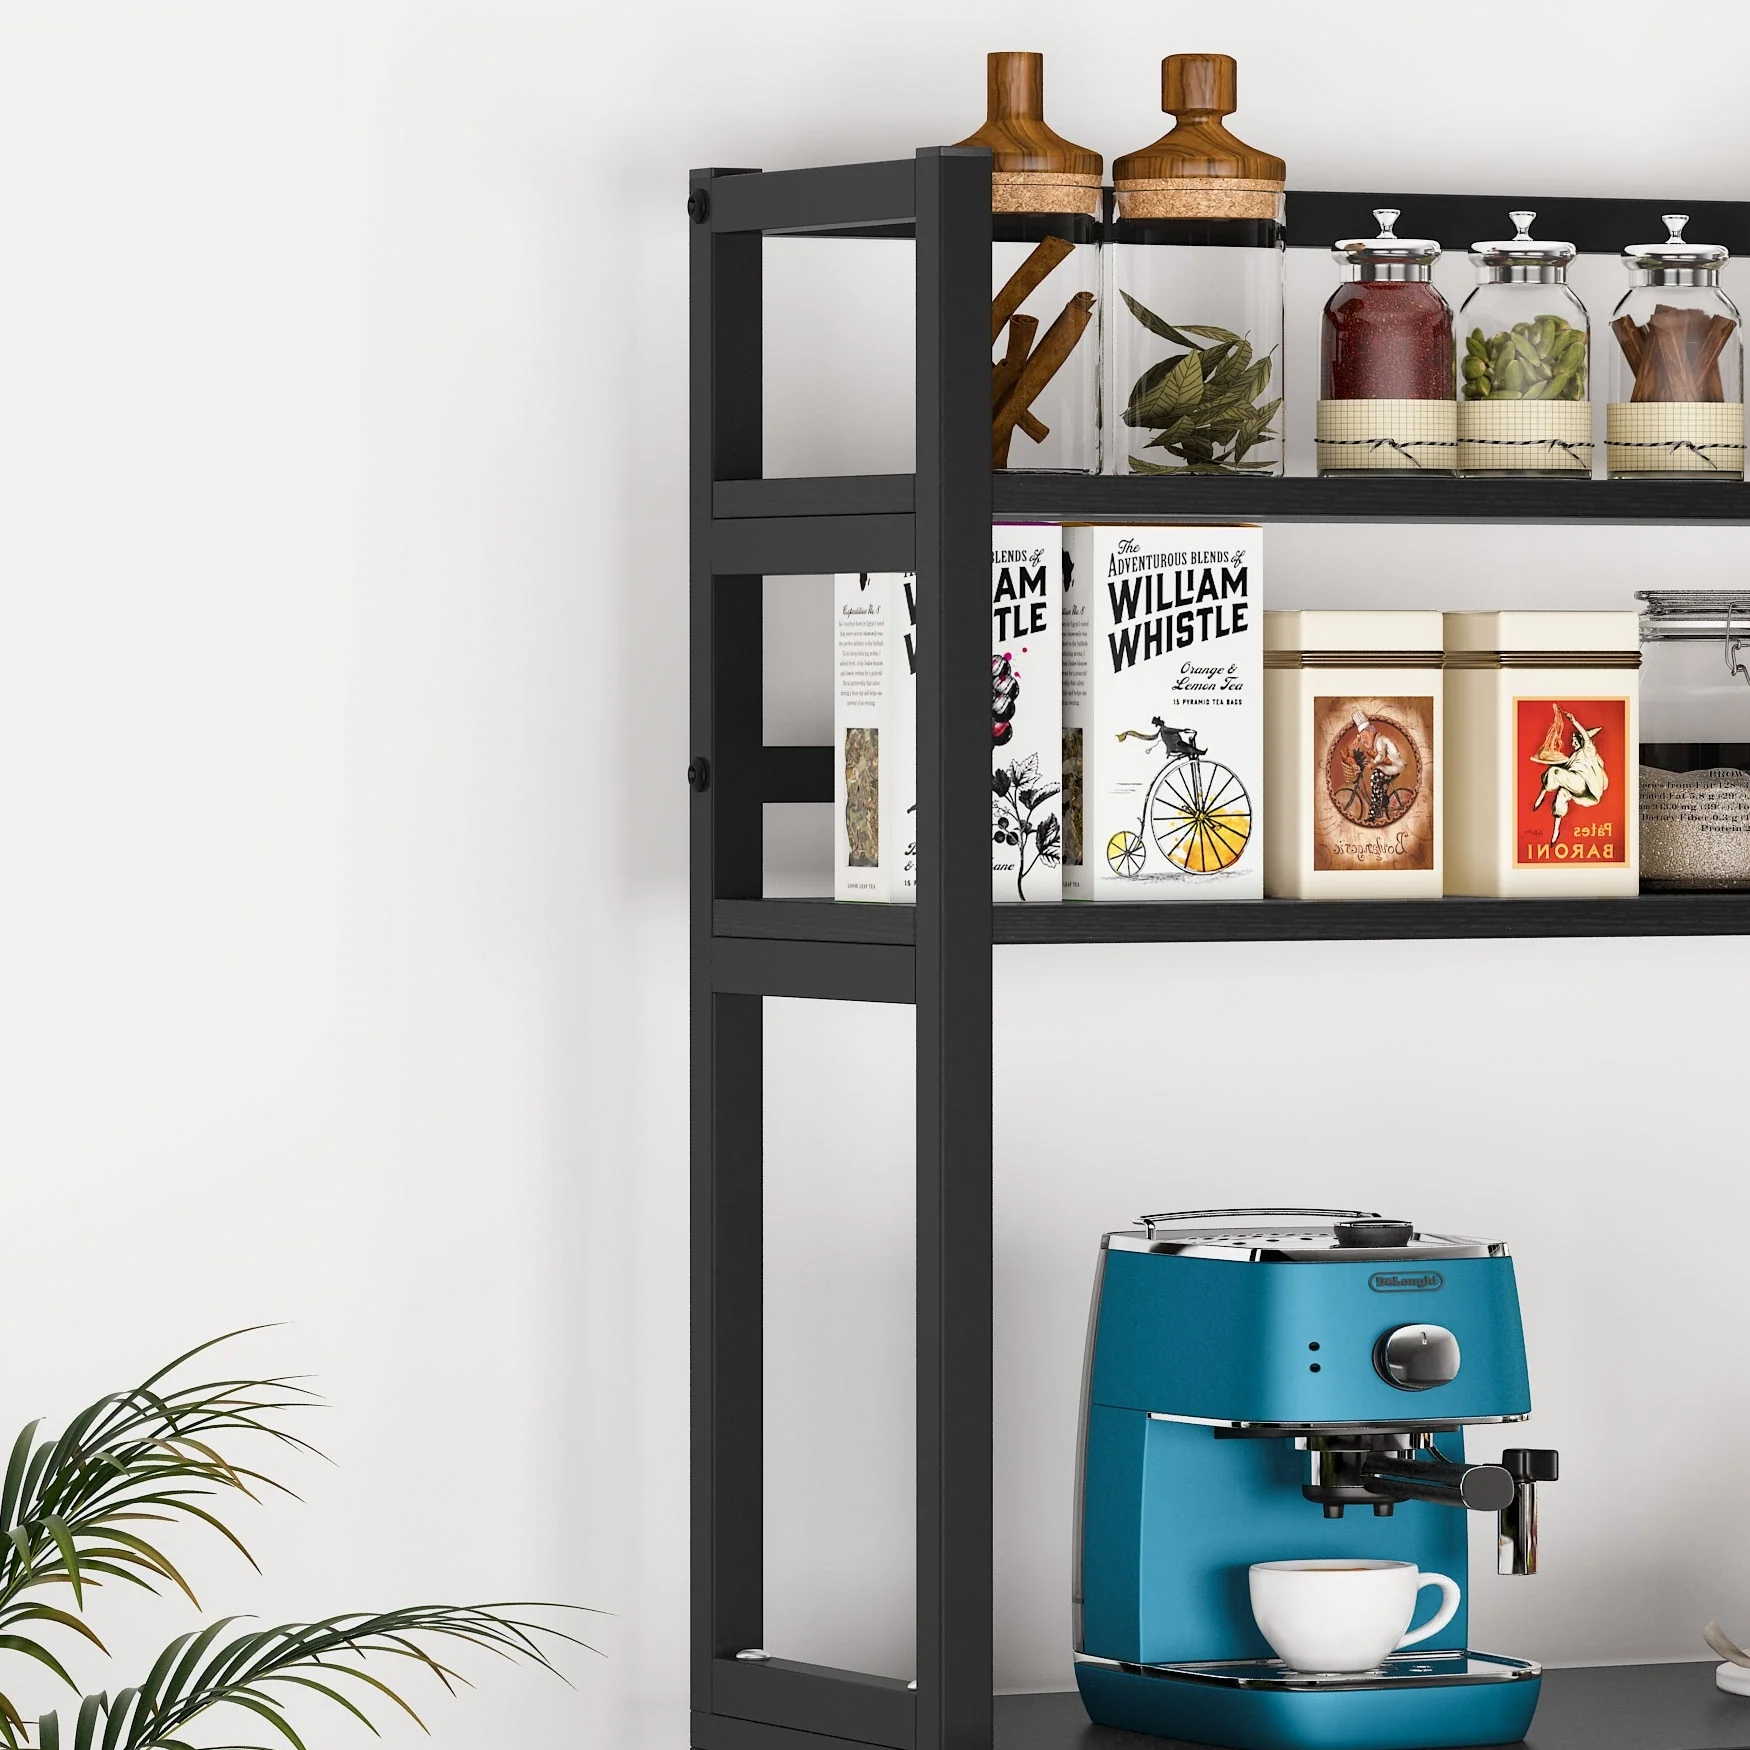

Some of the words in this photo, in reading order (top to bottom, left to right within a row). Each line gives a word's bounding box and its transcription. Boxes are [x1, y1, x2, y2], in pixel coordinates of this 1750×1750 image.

[1118, 538, 1140, 554] The
[1108, 552, 1187, 577] ADVENTUROUS
[1191, 551, 1229, 564] BLENDS
[1231, 550, 1246, 568] of
[1108, 567, 1248, 625] WILLIAM
[1108, 602, 1248, 673] WHISTLE
[1180, 661, 1225, 679] Orange
[1227, 664, 1238, 674] &
[1172, 677, 1216, 690] Lemon
[1220, 676, 1244, 690] Tea
